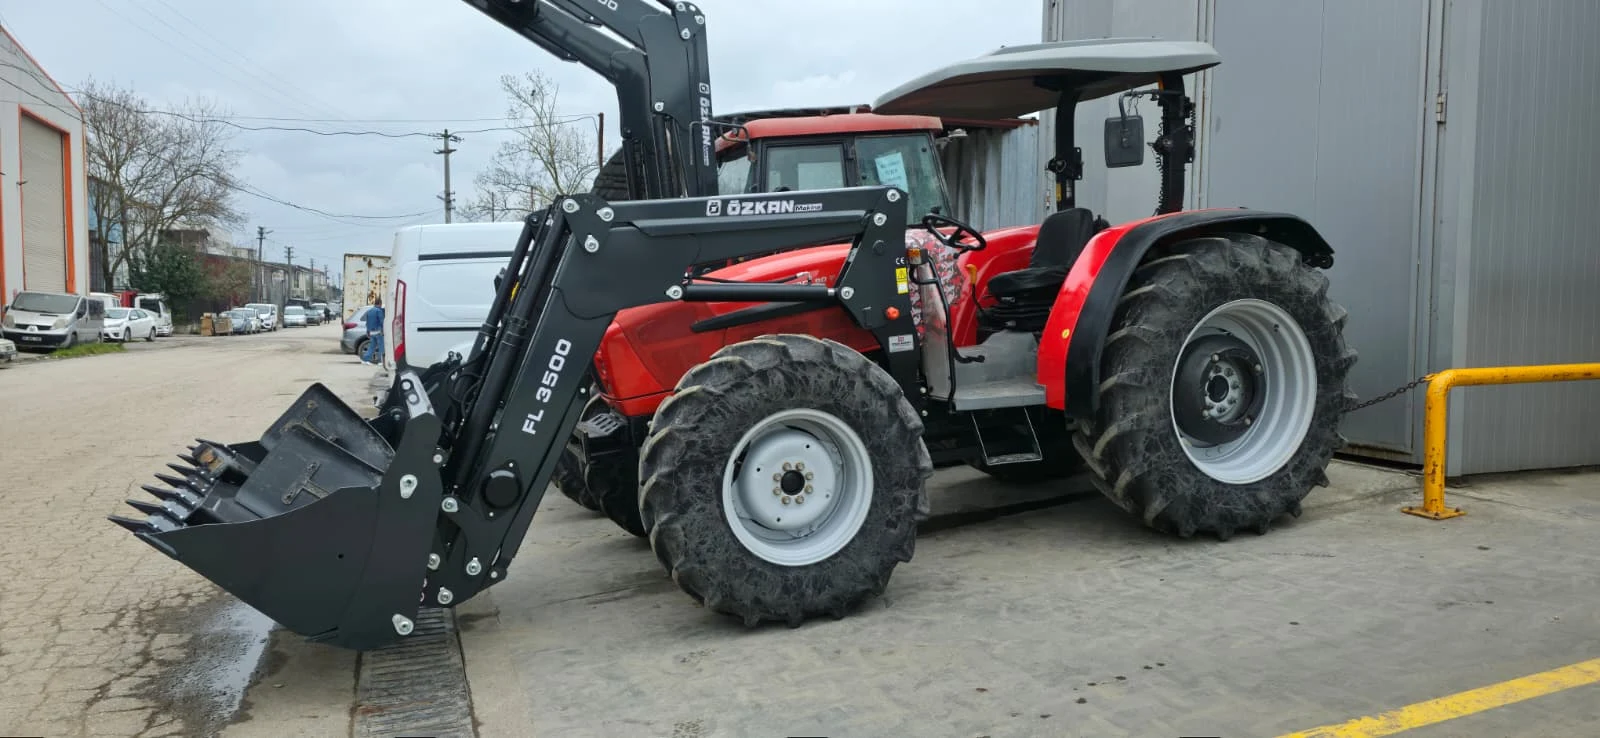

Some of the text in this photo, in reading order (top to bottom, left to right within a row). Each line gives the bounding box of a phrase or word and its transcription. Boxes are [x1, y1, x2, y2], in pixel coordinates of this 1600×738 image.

[727, 200, 794, 216] ÖZKAN
[895, 257, 905, 265] CE
[522, 339, 571, 434] FL 3500
